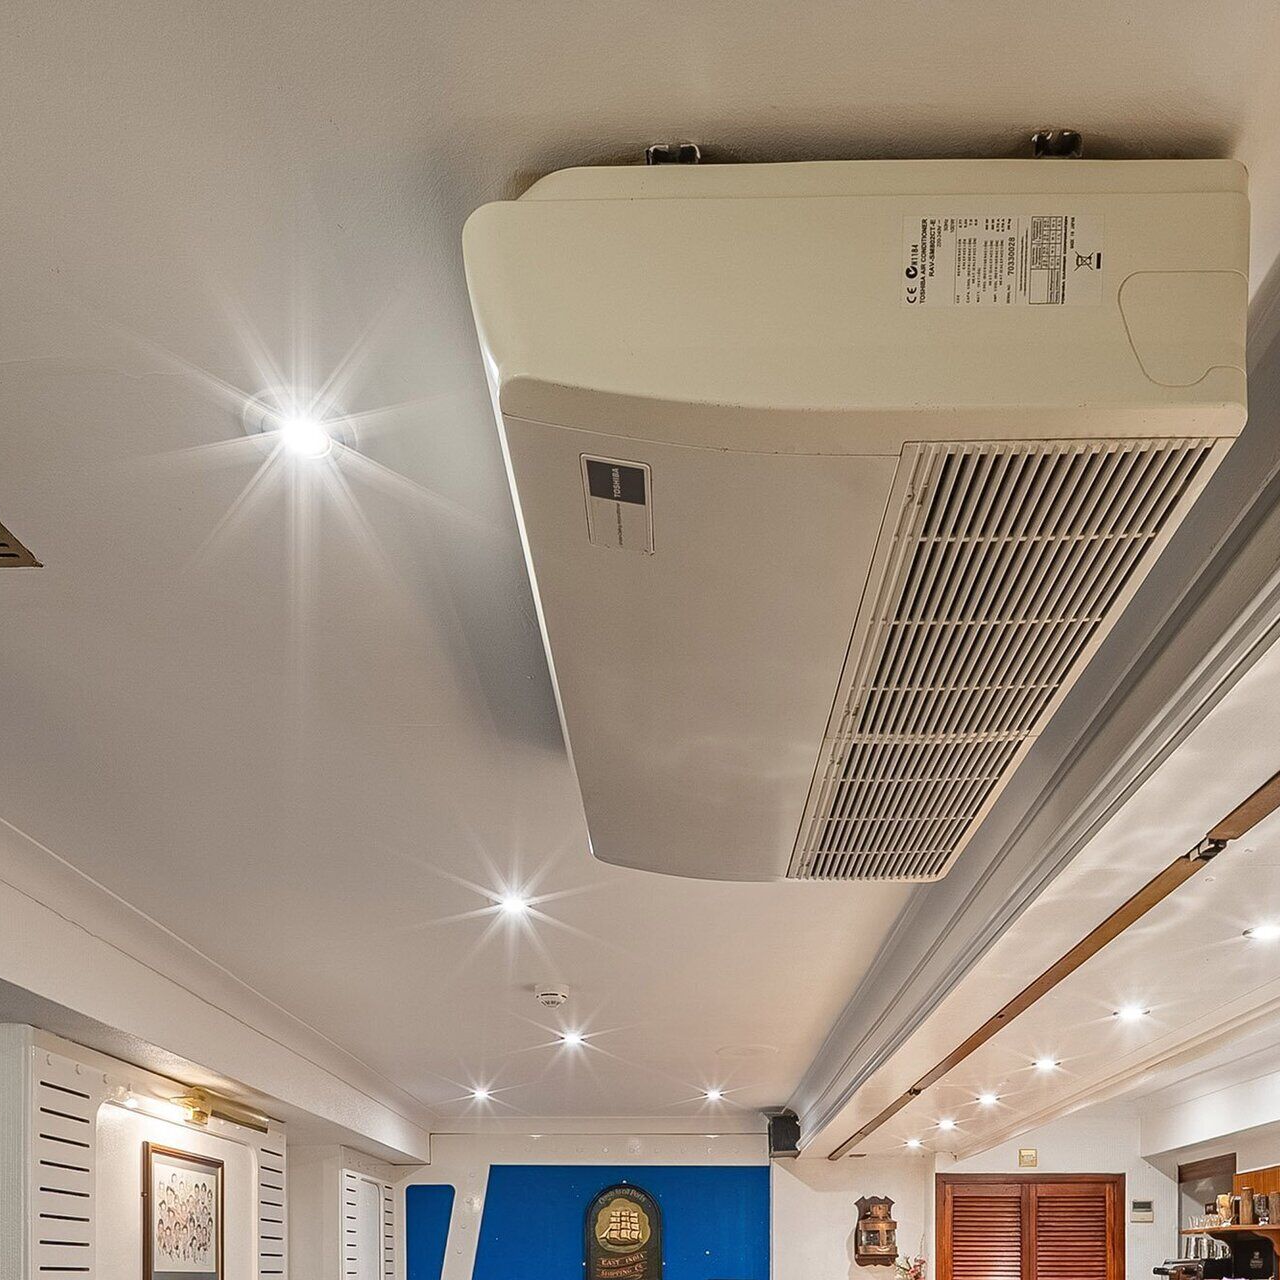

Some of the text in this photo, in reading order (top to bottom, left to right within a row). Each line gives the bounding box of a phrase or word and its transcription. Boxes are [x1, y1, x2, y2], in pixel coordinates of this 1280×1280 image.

[920, 218, 928, 263] CONDITIONER
[1007, 236, 1016, 276] 70330028
[611, 467, 621, 498] TOSHIBA
